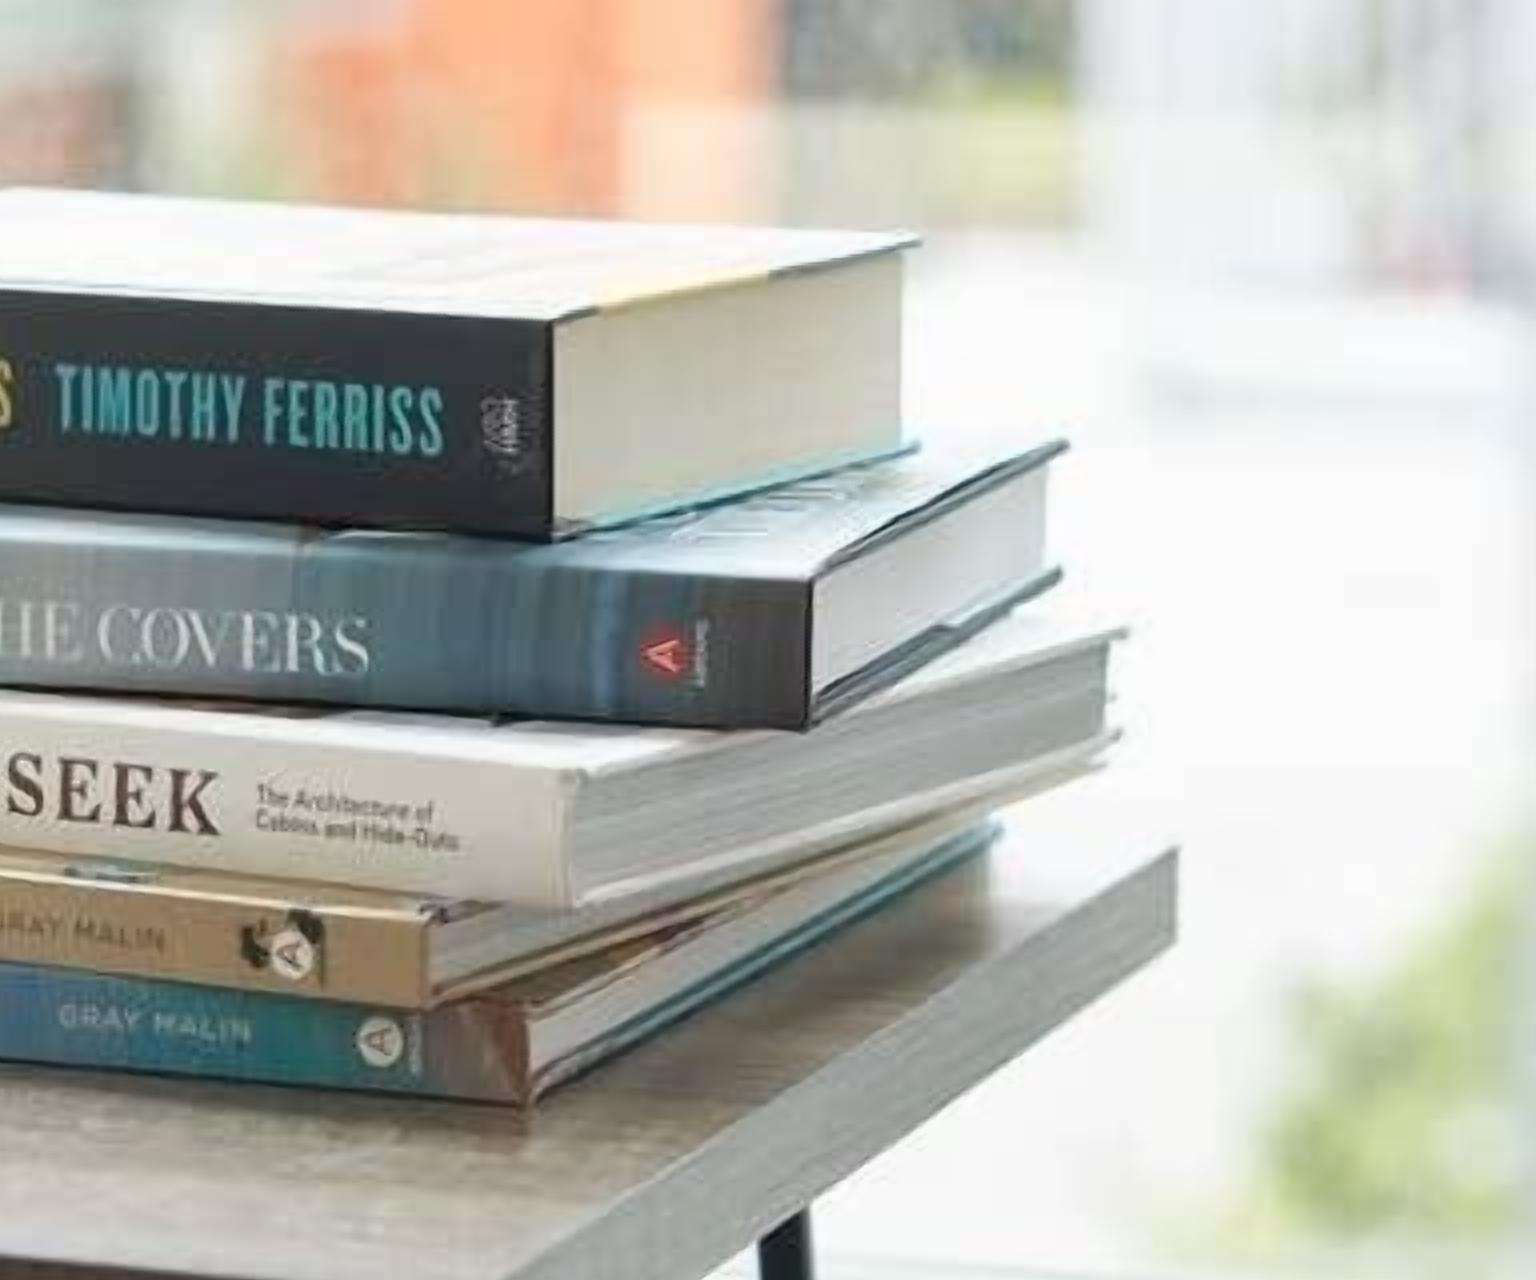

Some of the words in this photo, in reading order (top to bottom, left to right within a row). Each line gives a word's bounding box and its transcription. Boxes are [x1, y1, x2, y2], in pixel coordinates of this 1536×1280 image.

[56, 363, 246, 443] TIMOTHY
[264, 377, 444, 456] FERRISS
[96, 607, 369, 676] COVERS
[7, 751, 222, 837] SEEK
[73, 915, 164, 952] MALIN
[58, 1004, 142, 1030] GRAY
[153, 1010, 251, 1044] MALIN
